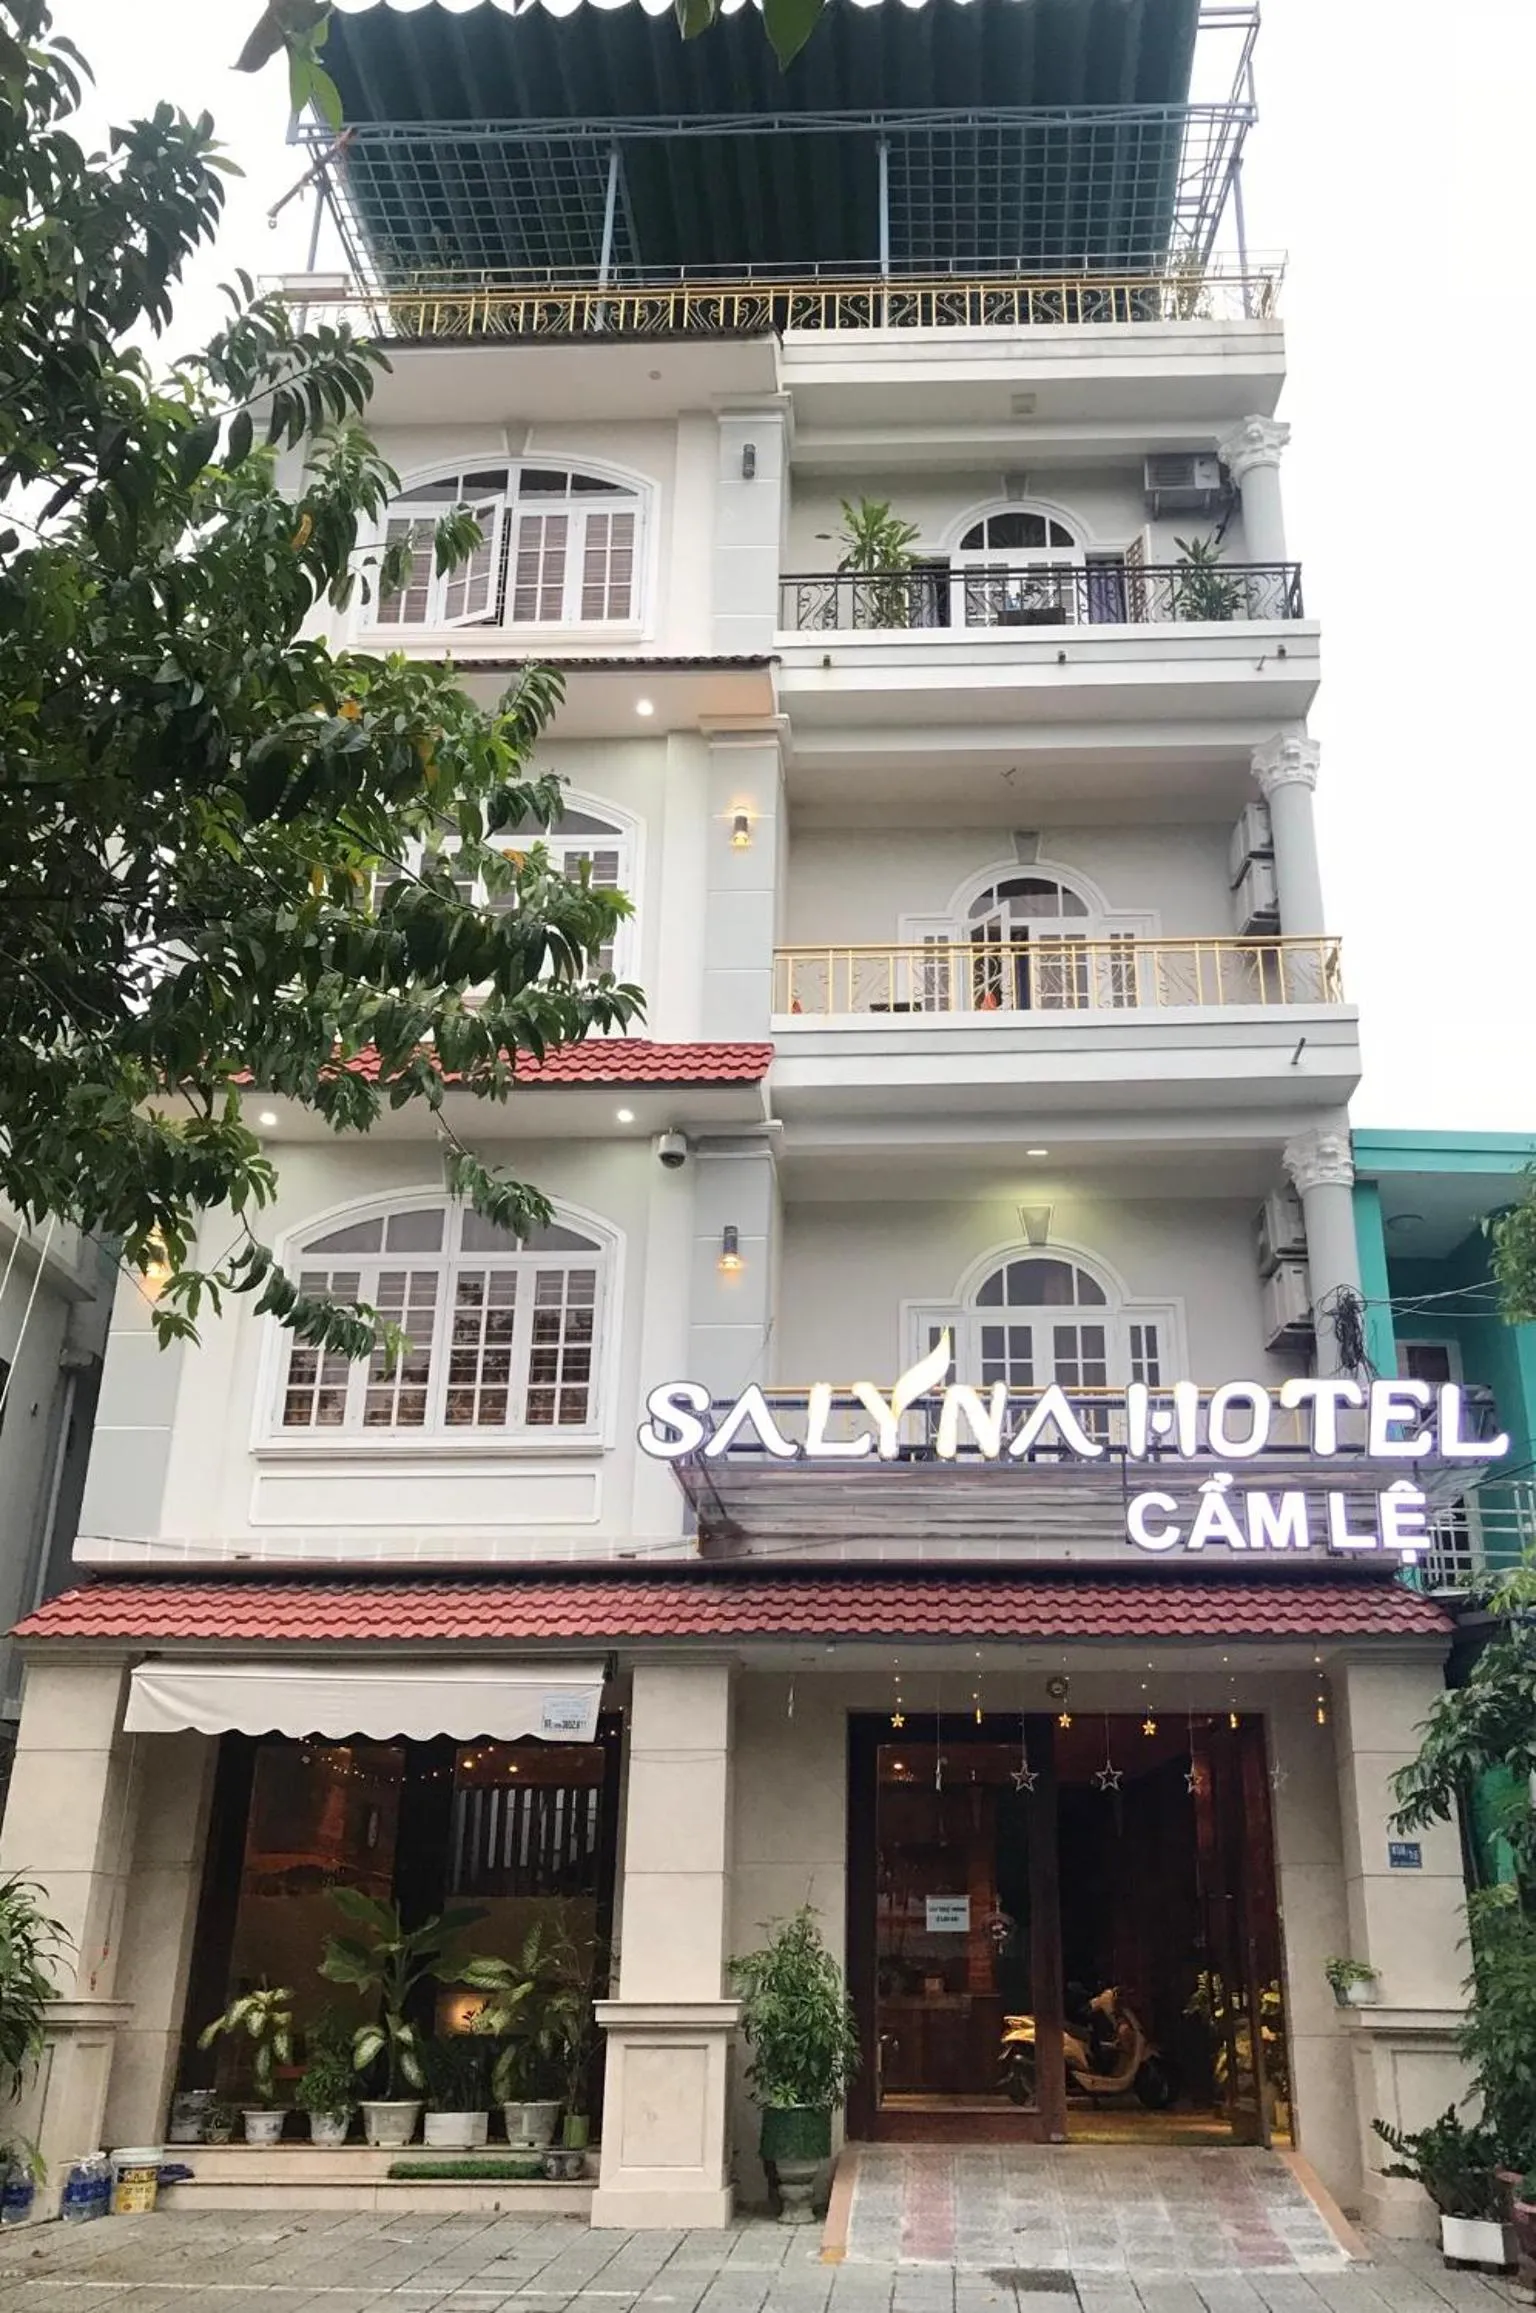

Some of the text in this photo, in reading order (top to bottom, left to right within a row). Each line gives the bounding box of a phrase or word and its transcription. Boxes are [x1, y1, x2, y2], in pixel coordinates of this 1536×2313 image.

[637, 1326, 1510, 1459] SALYNA HOTEL
[1328, 1479, 1431, 1564] LỆ
